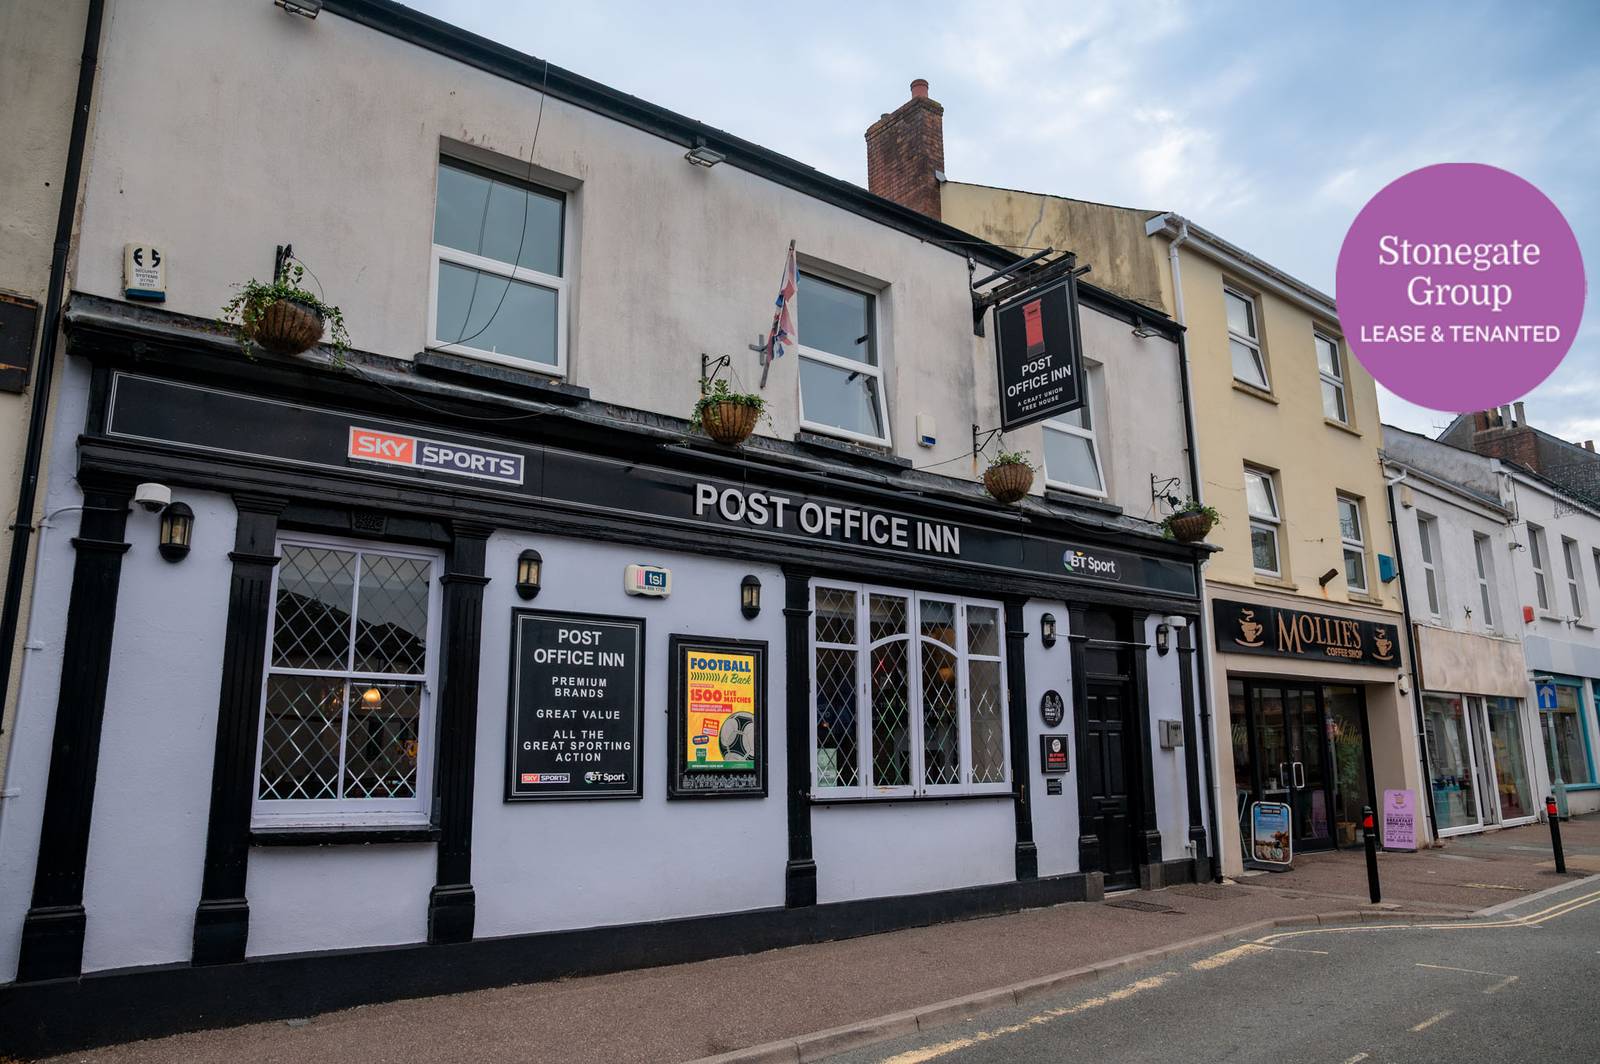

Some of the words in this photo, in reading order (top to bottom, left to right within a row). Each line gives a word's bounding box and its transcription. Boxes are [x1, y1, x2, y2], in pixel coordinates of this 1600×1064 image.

[1022, 354, 1052, 377] POST
[1007, 373, 1049, 398] OFFICE
[1051, 364, 1072, 383] INN
[1023, 394, 1042, 406] CRAFT
[1044, 386, 1063, 400] UNION
[1022, 402, 1037, 412] FREE
[1039, 395, 1059, 408] HOUSE
[358, 436, 408, 458] SKY
[422, 446, 515, 476] SPORTS
[696, 482, 790, 528] POST
[800, 502, 908, 548] OFFICE
[916, 522, 960, 555] INN
[1070, 555, 1086, 568] BT
[1088, 556, 1116, 573] Sport
[649, 572, 662, 585] tsi
[558, 629, 602, 646] POST
[1278, 612, 1362, 654] MOLLIE'S
[534, 648, 594, 665] OFFICE
[598, 652, 625, 667] INN
[1326, 647, 1347, 657] COFFEE
[1348, 650, 1363, 659] SHOP
[691, 658, 751, 672] FOOTBALL
[552, 676, 607, 687] PREMIUM
[720, 674, 728, 684] Is
[730, 673, 751, 685] Back
[555, 688, 604, 698] BRANDS
[690, 688, 722, 702] 1500
[536, 709, 577, 719] GREAT
[582, 710, 620, 720] VALUE
[553, 730, 576, 739] ALL
[581, 730, 604, 739] THE
[524, 741, 565, 750] GREAT
[570, 741, 631, 750] SPORTING
[555, 753, 601, 762] ACTION
[590, 772, 602, 781] BT
[603, 773, 625, 782] Sport
